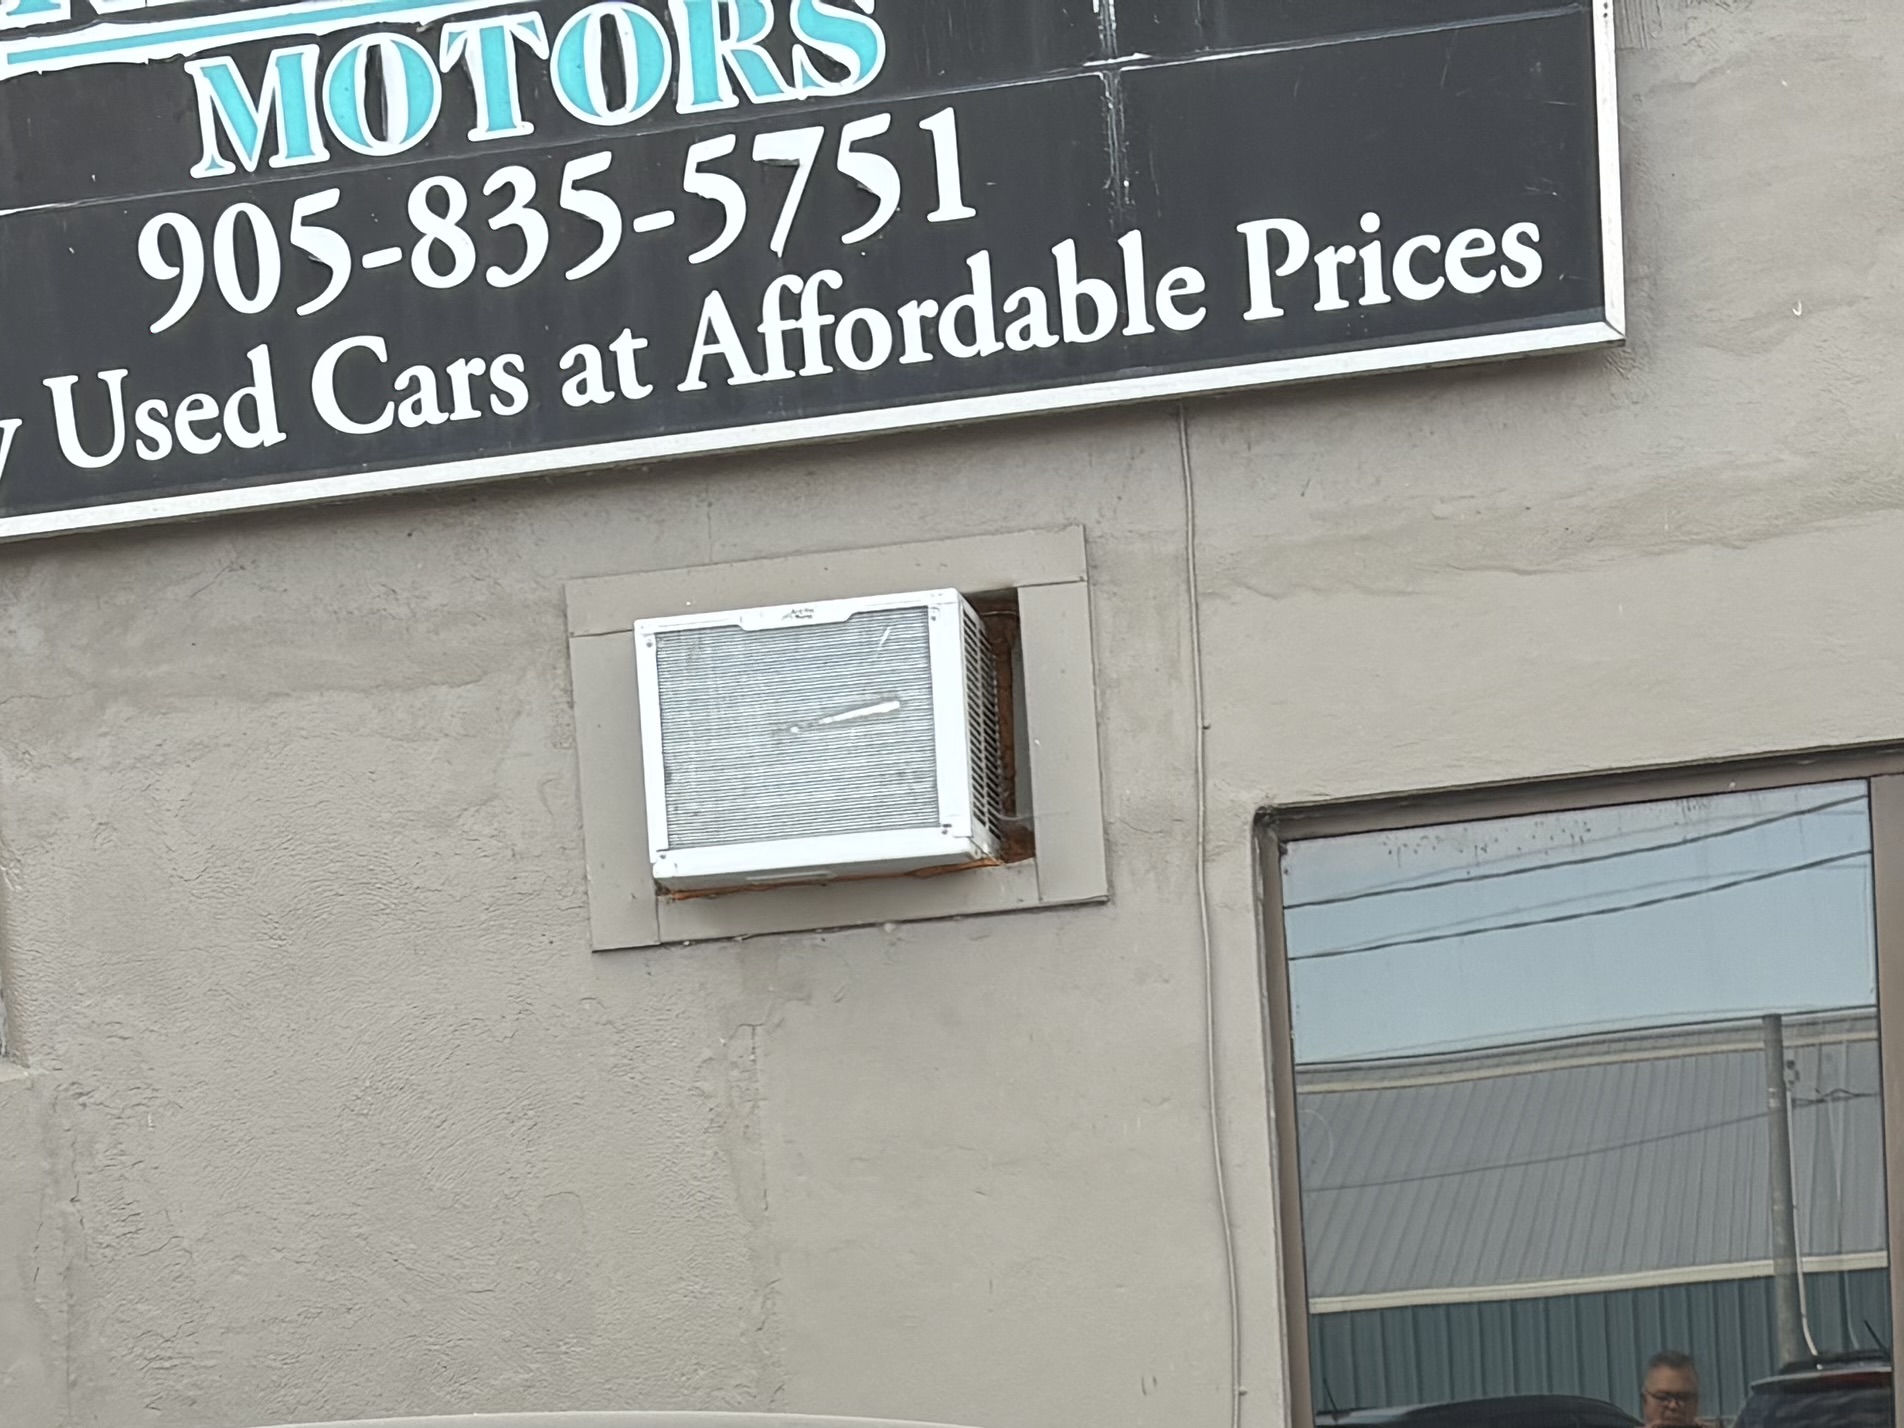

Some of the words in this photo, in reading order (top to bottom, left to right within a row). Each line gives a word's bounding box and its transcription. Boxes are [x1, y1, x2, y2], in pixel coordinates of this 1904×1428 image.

[183, 0, 887, 178] MOTORS
[137, 106, 977, 334] 905-835-5751
[42, 344, 287, 469] Used
[311, 335, 529, 435] Cars
[559, 327, 654, 407] at
[676, 230, 1207, 392] Affordable
[1236, 210, 1543, 321] Prices
